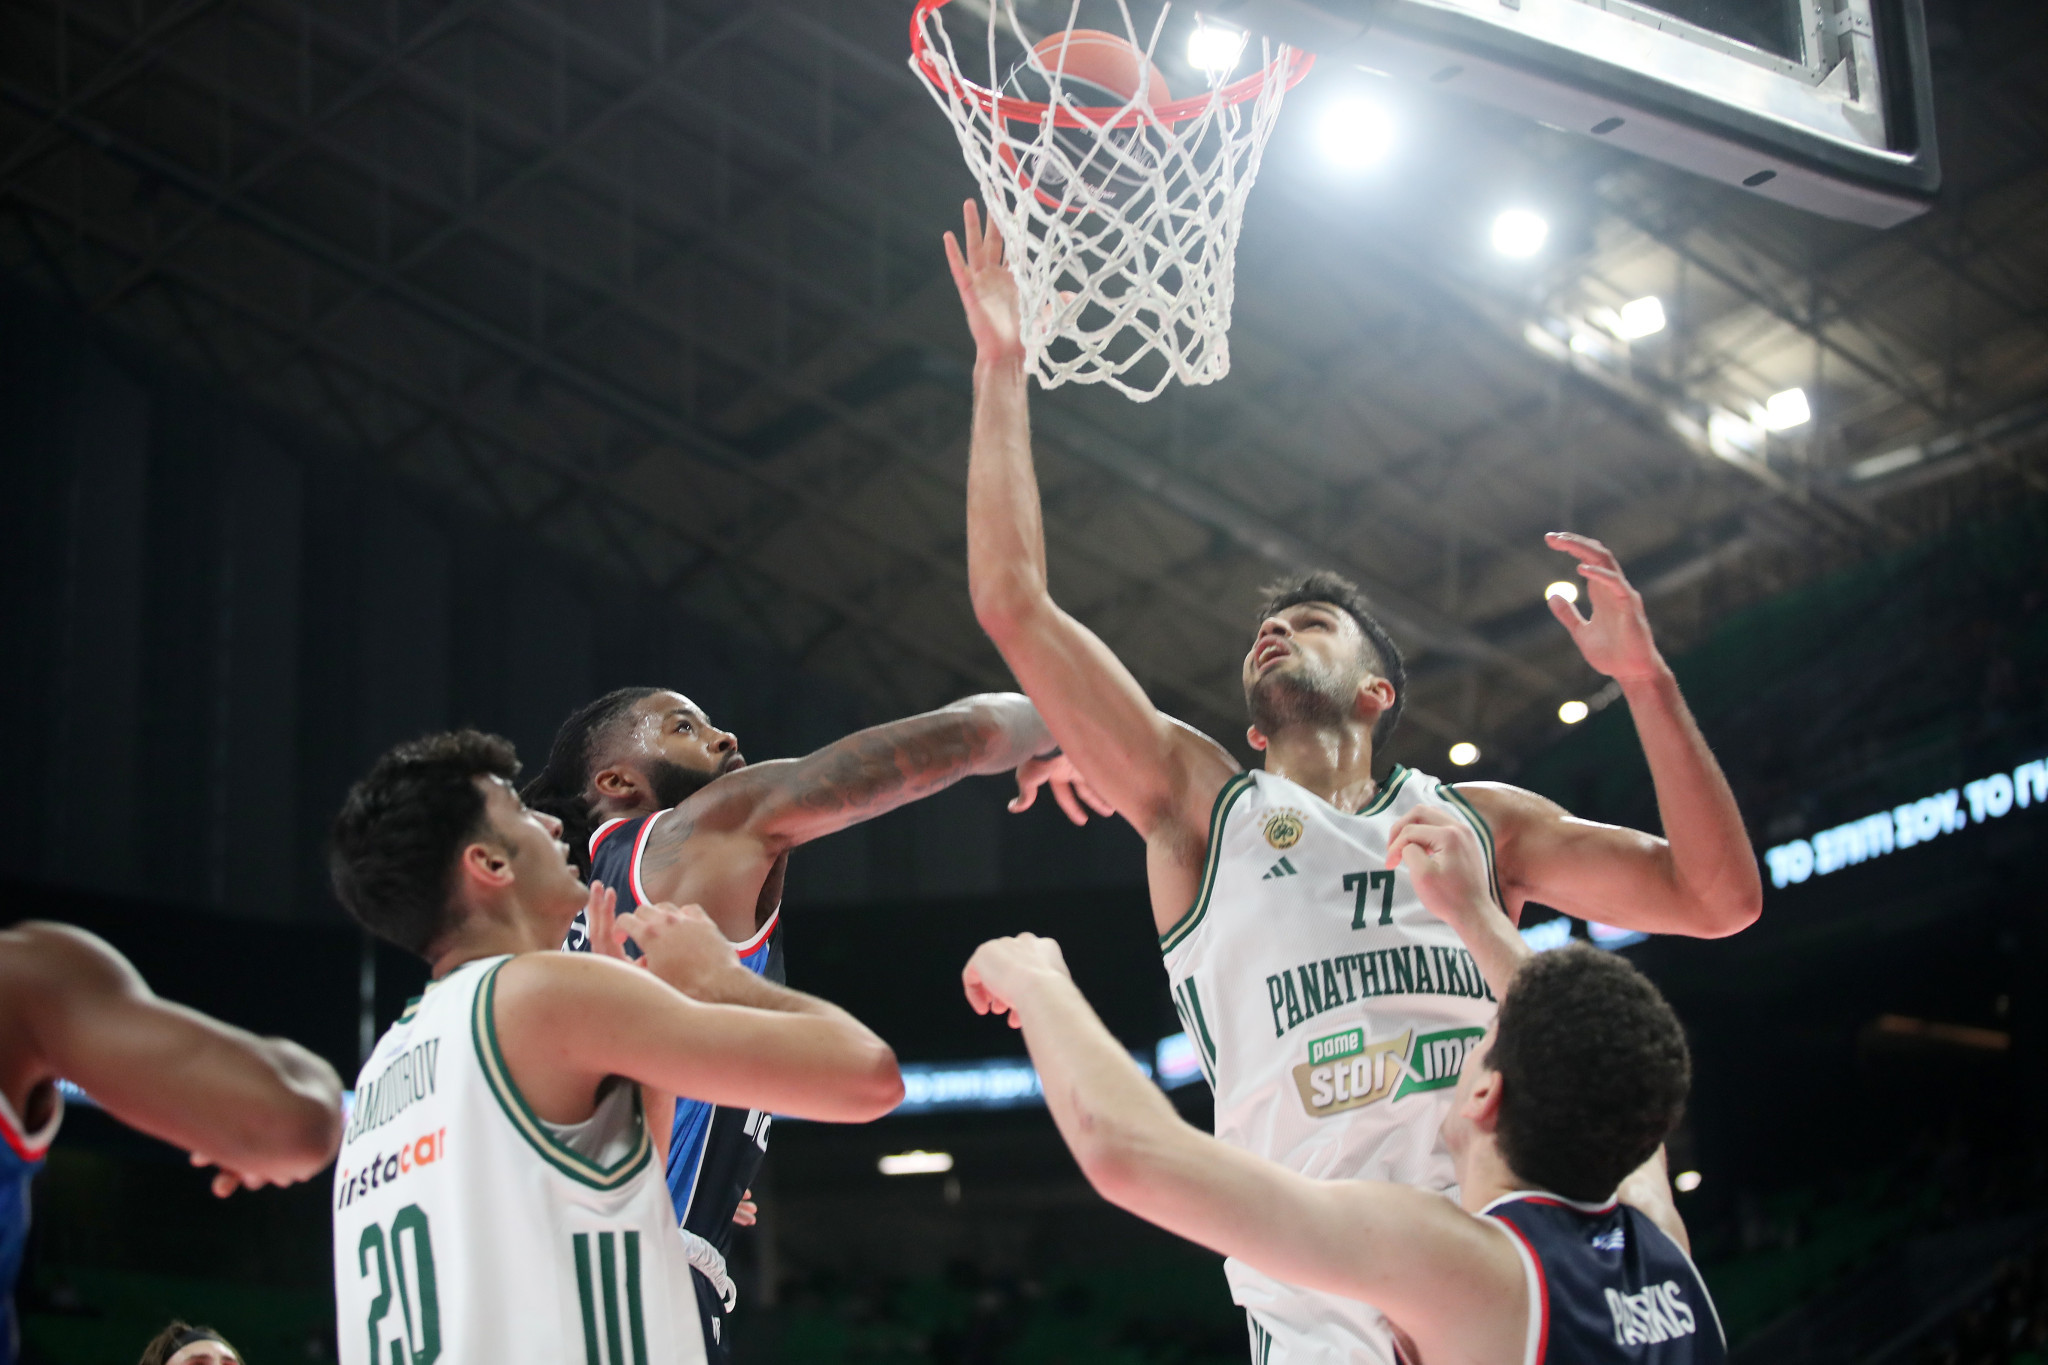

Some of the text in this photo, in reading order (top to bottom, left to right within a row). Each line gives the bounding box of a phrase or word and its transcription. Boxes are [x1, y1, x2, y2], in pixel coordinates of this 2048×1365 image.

[1342, 869, 1396, 930] 77
[1265, 945, 1497, 1039] PANATHINAIKO
[1312, 1031, 1360, 1064] pame
[337, 1126, 447, 1211] instacar
[357, 1202, 443, 1365] 20
